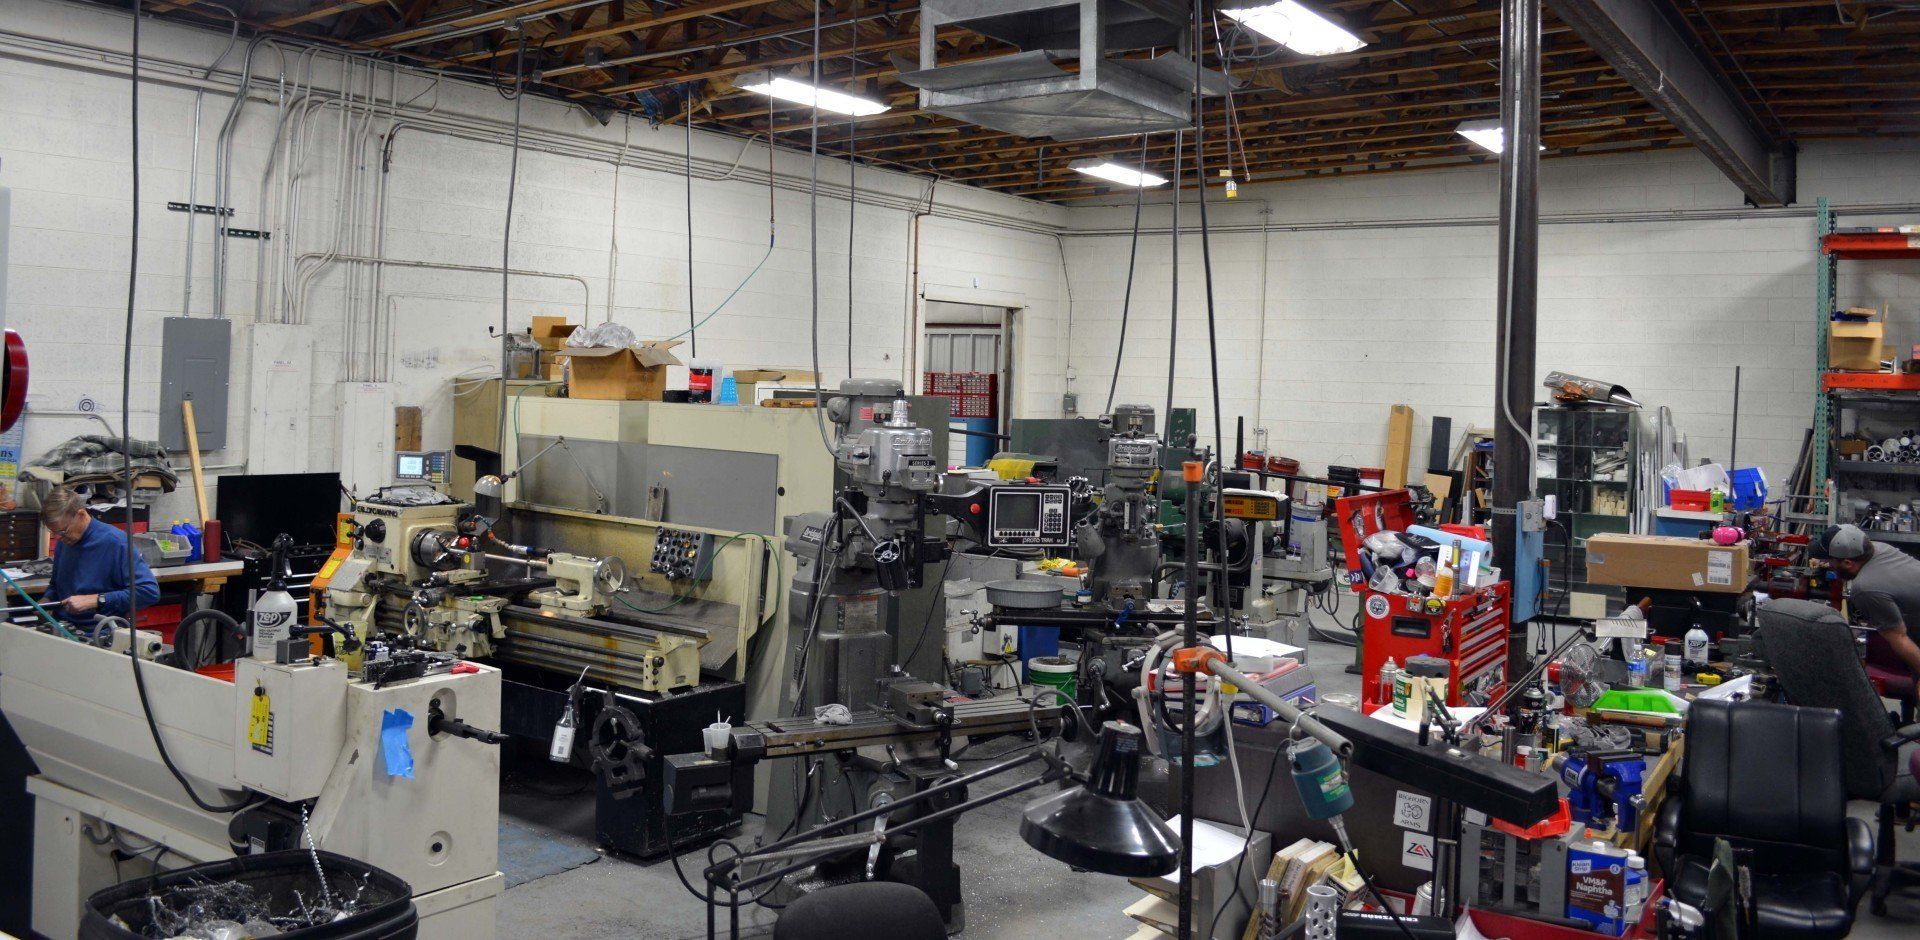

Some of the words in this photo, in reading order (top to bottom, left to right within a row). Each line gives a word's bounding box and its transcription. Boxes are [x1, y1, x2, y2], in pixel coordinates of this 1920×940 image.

[1398, 792, 1429, 805] BIGHORN
[1401, 819, 1421, 828] ARMS
[1582, 876, 1607, 886] VM&P
[1576, 882, 1613, 895] Naphtha
[1361, 913, 1418, 922] CRATSMAN
